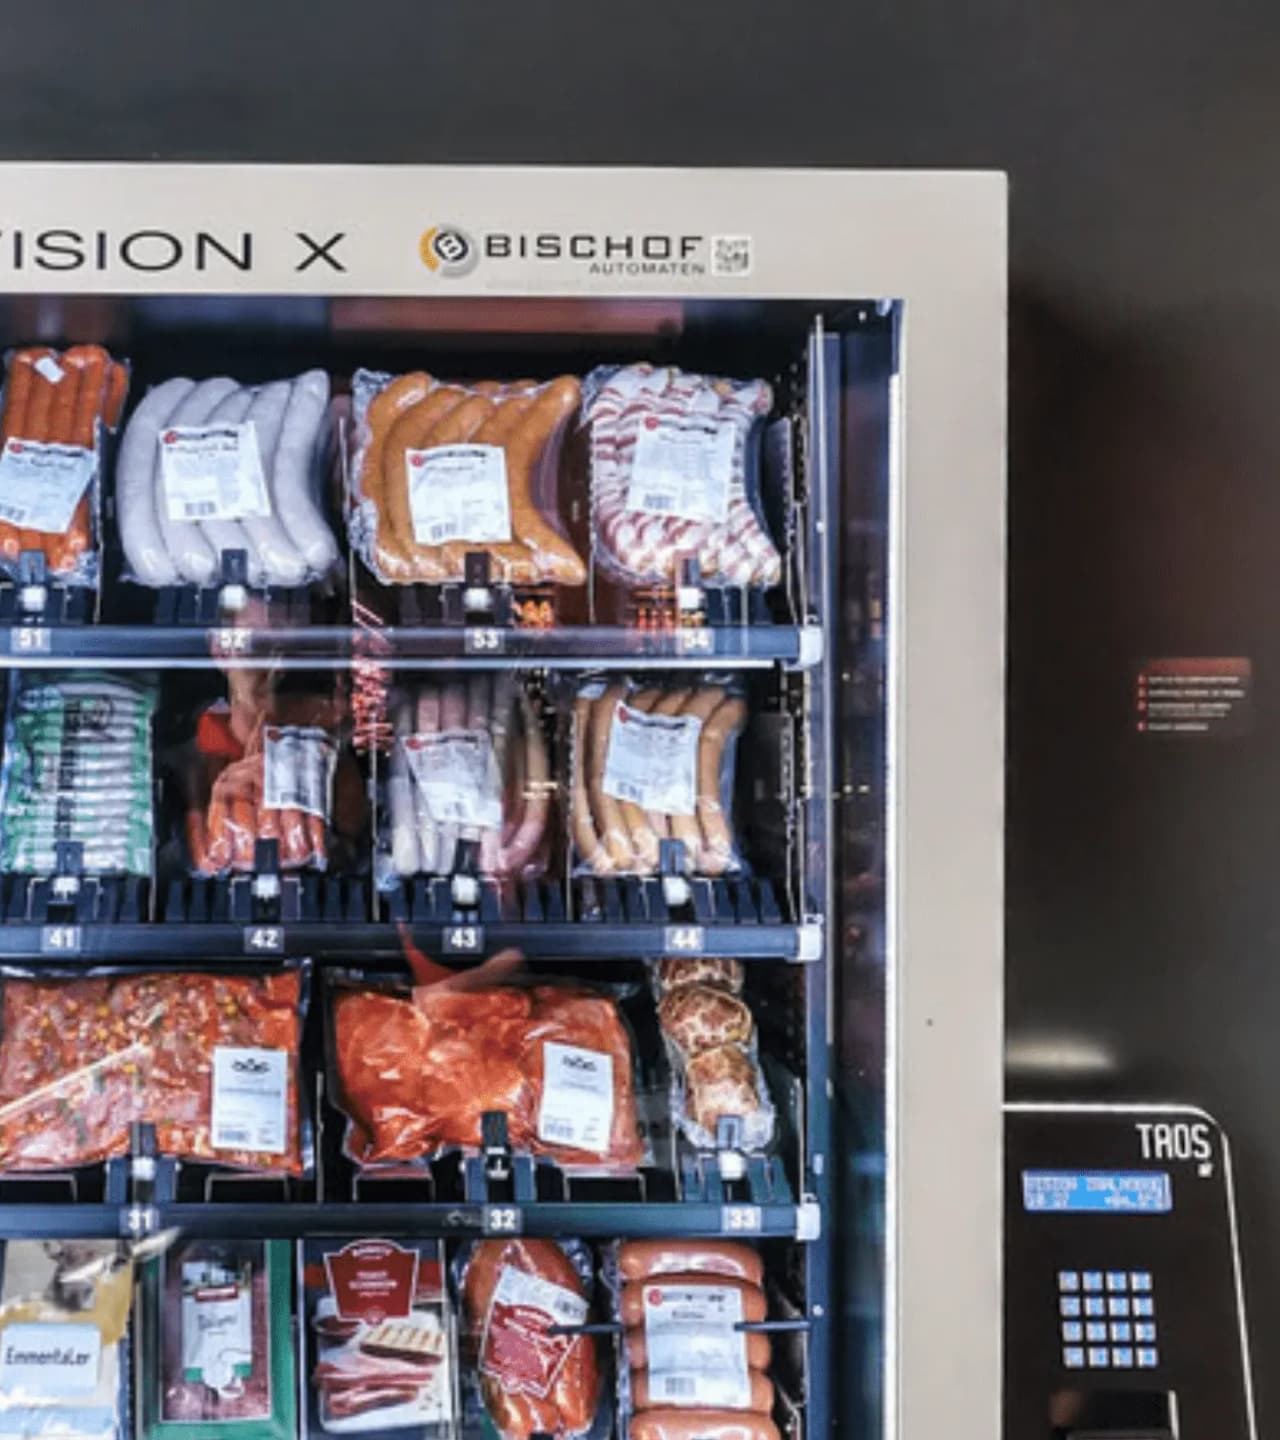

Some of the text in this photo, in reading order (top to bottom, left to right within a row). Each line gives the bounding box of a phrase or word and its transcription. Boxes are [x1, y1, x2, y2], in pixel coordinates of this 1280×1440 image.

[295, 232, 347, 272] X
[485, 235, 703, 260] BISCHOF
[589, 262, 706, 276] AUTOMATEN
[19, 627, 44, 648] 51
[219, 627, 247, 649] 52
[473, 630, 499, 650] 53
[685, 630, 710, 650] 54
[48, 928, 75, 949] 41
[250, 928, 279, 949] 42
[450, 929, 476, 949] 43
[671, 929, 698, 949] 44
[1136, 1124, 1212, 1160] TAOS
[491, 1209, 516, 1230] 32
[729, 1208, 755, 1228] 33
